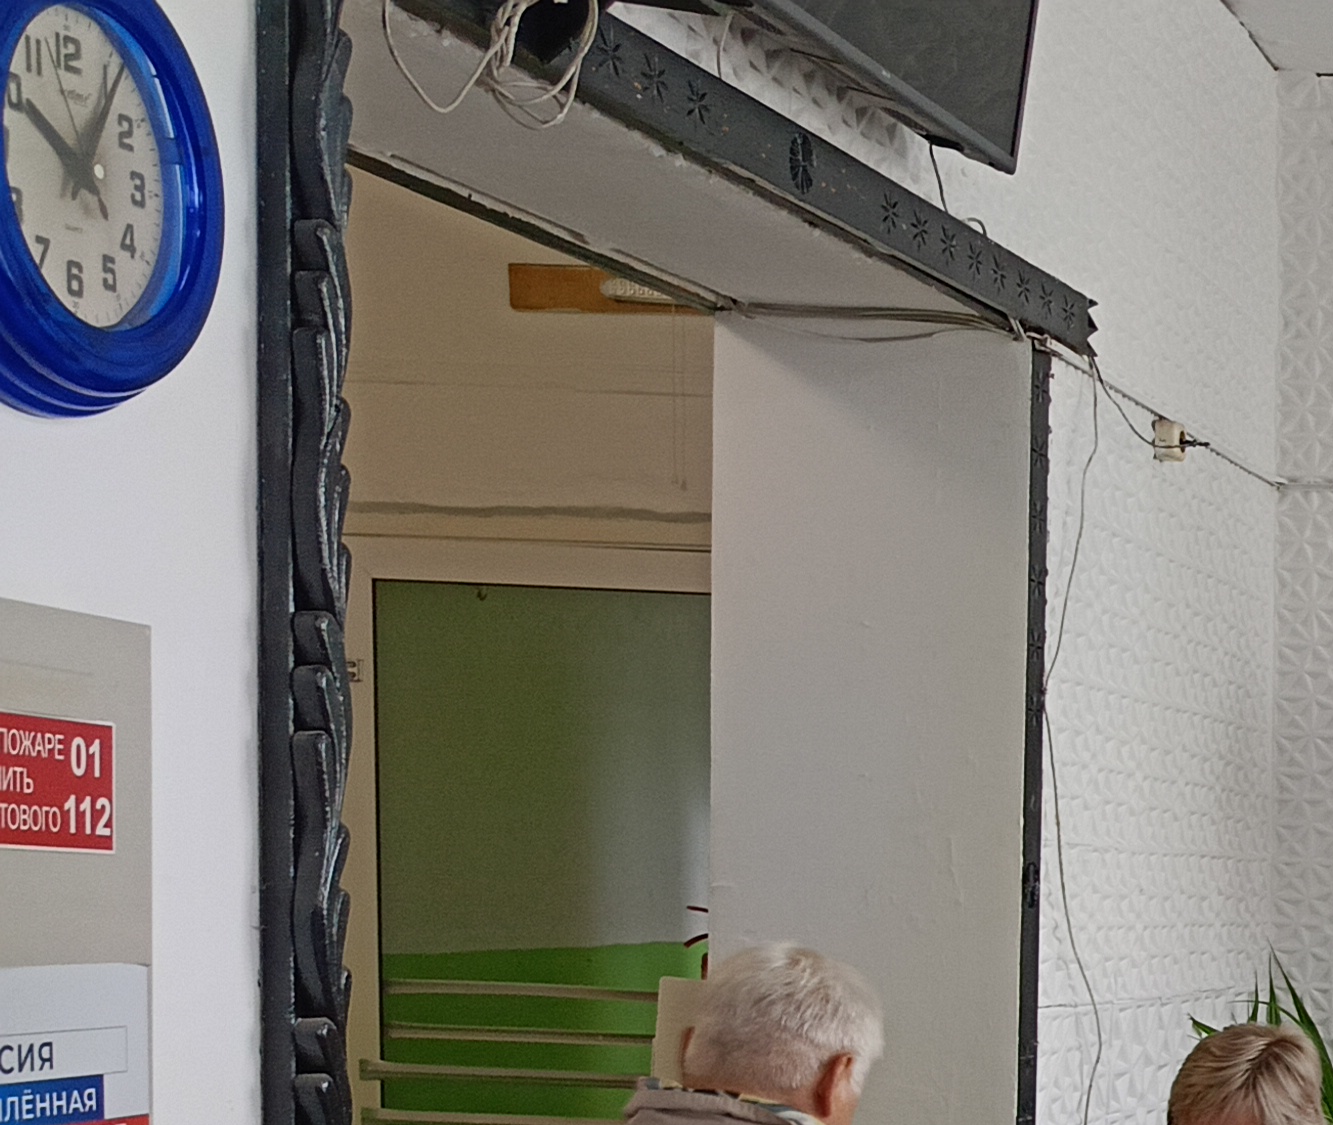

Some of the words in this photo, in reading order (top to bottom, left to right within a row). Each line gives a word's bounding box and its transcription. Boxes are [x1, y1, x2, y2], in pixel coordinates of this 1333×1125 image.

[25, 34, 42, 76] 11
[55, 31, 82, 75] 12
[117, 113, 134, 153] 2
[129, 170, 146, 209] 3
[35, 234, 51, 271] 7
[120, 223, 136, 259] 4
[66, 259, 84, 299] 6
[102, 254, 117, 293] 5
[70, 736, 101, 778] 01
[64, 794, 112, 836] 112
[0, 1088, 97, 1122] ЛЁННАЯ
